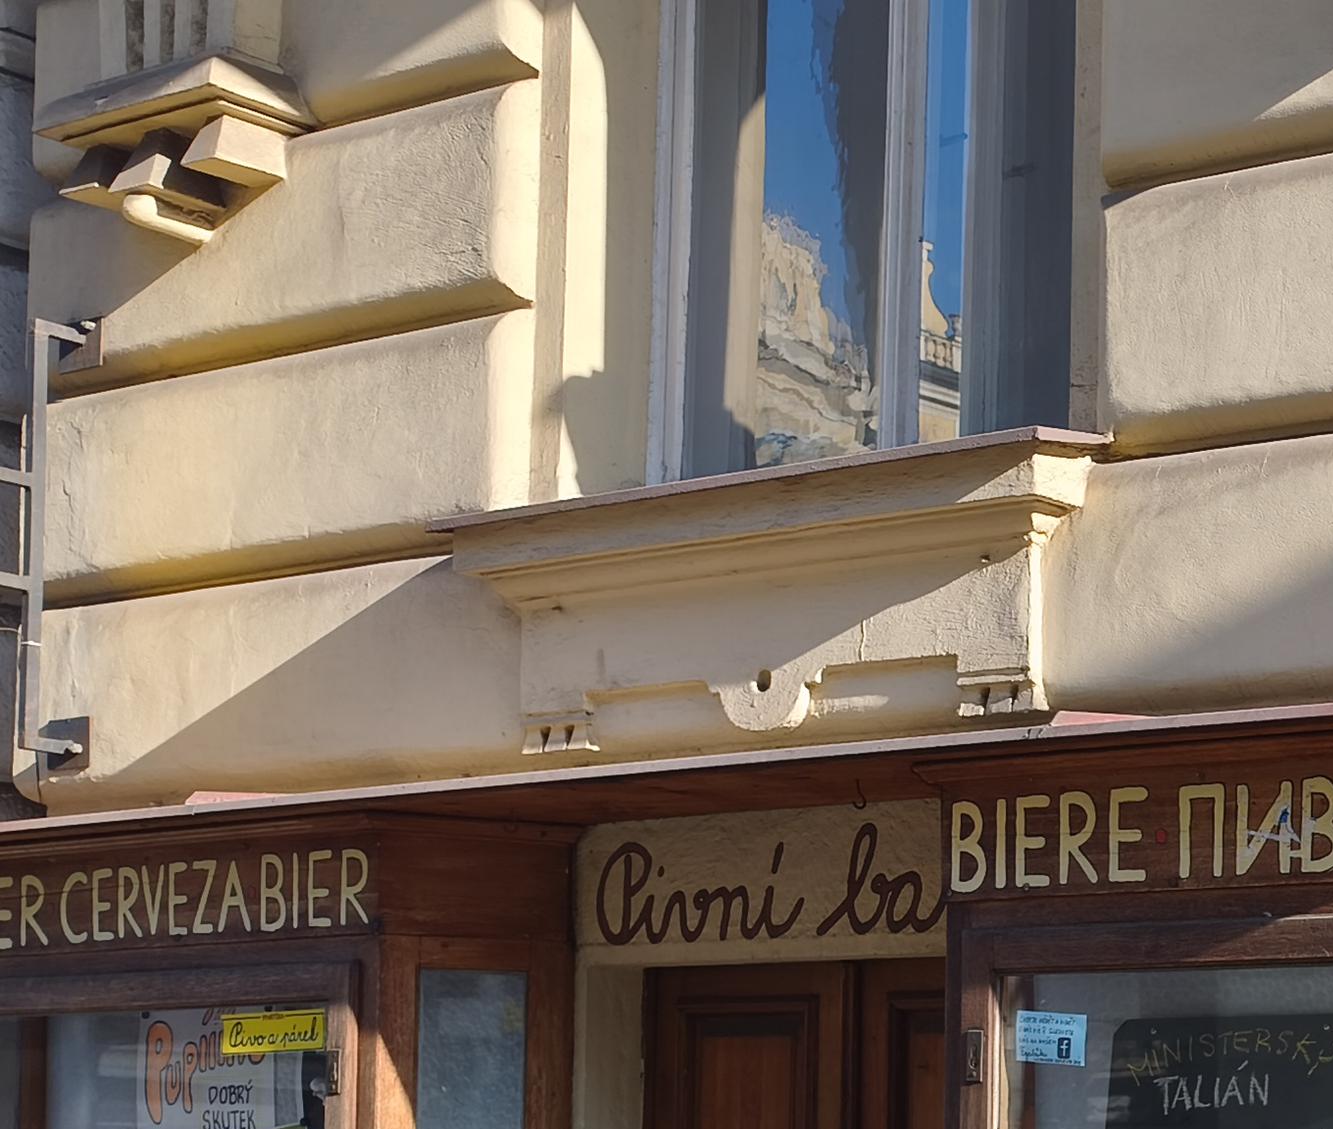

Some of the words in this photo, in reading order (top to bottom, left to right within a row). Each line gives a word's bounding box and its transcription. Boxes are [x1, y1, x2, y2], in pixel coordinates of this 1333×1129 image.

[950, 787, 1150, 893] BIERE
[60, 858, 251, 944] CERVEZA
[260, 847, 370, 935] BIER
[596, 841, 806, 945] Pivní
[229, 1021, 267, 1047] Pivo
[268, 1033, 279, 1045] a
[208, 1079, 253, 1104] DOBRÝ
[1153, 1060, 1269, 1116] TALIÁN
